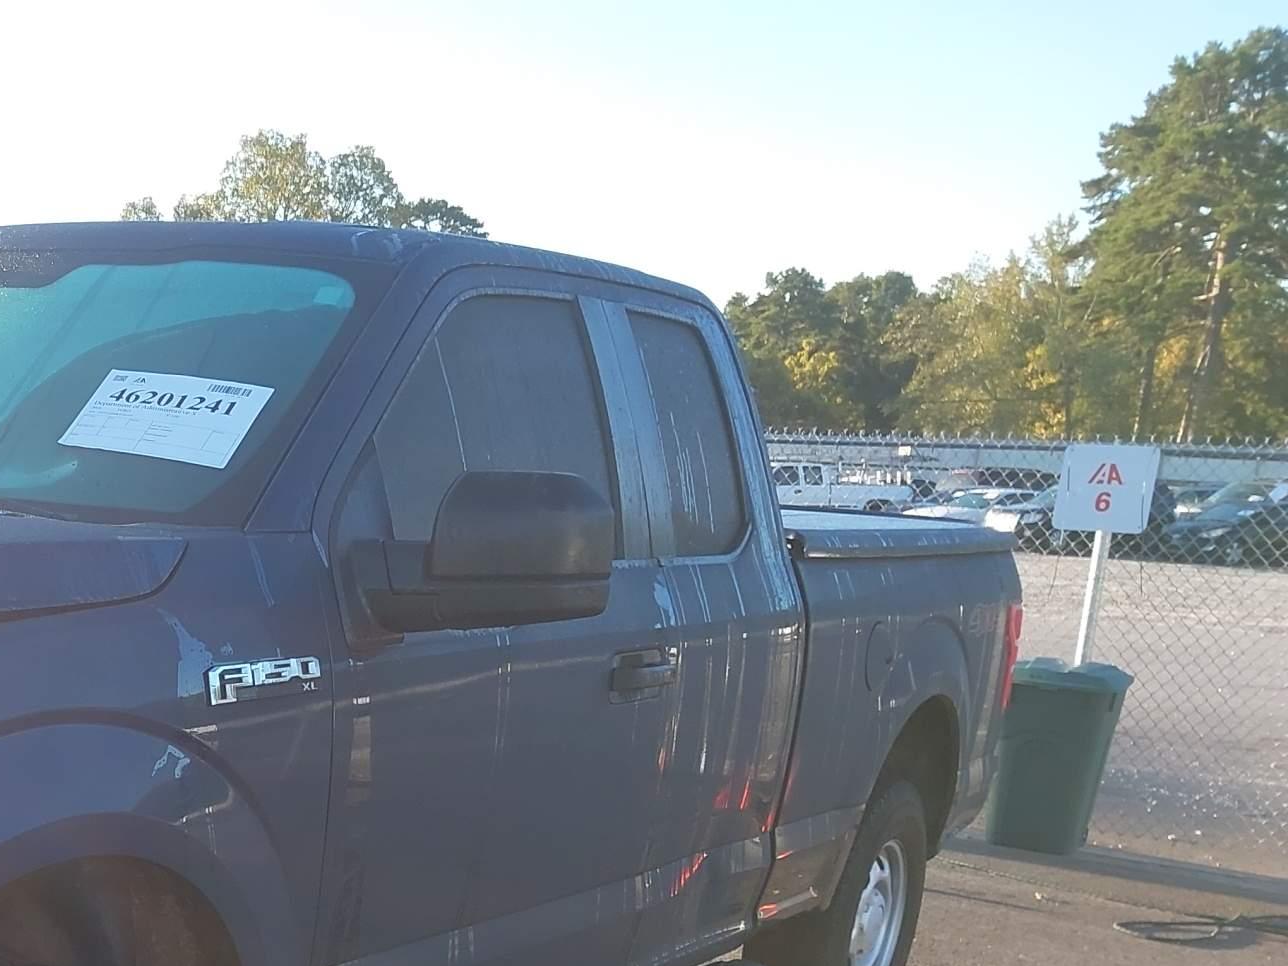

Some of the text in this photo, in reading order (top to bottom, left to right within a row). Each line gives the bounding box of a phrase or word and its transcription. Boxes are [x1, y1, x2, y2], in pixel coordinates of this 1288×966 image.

[109, 387, 238, 417] 46201241
[1094, 491, 1112, 512] 6
[301, 681, 318, 692] XL
